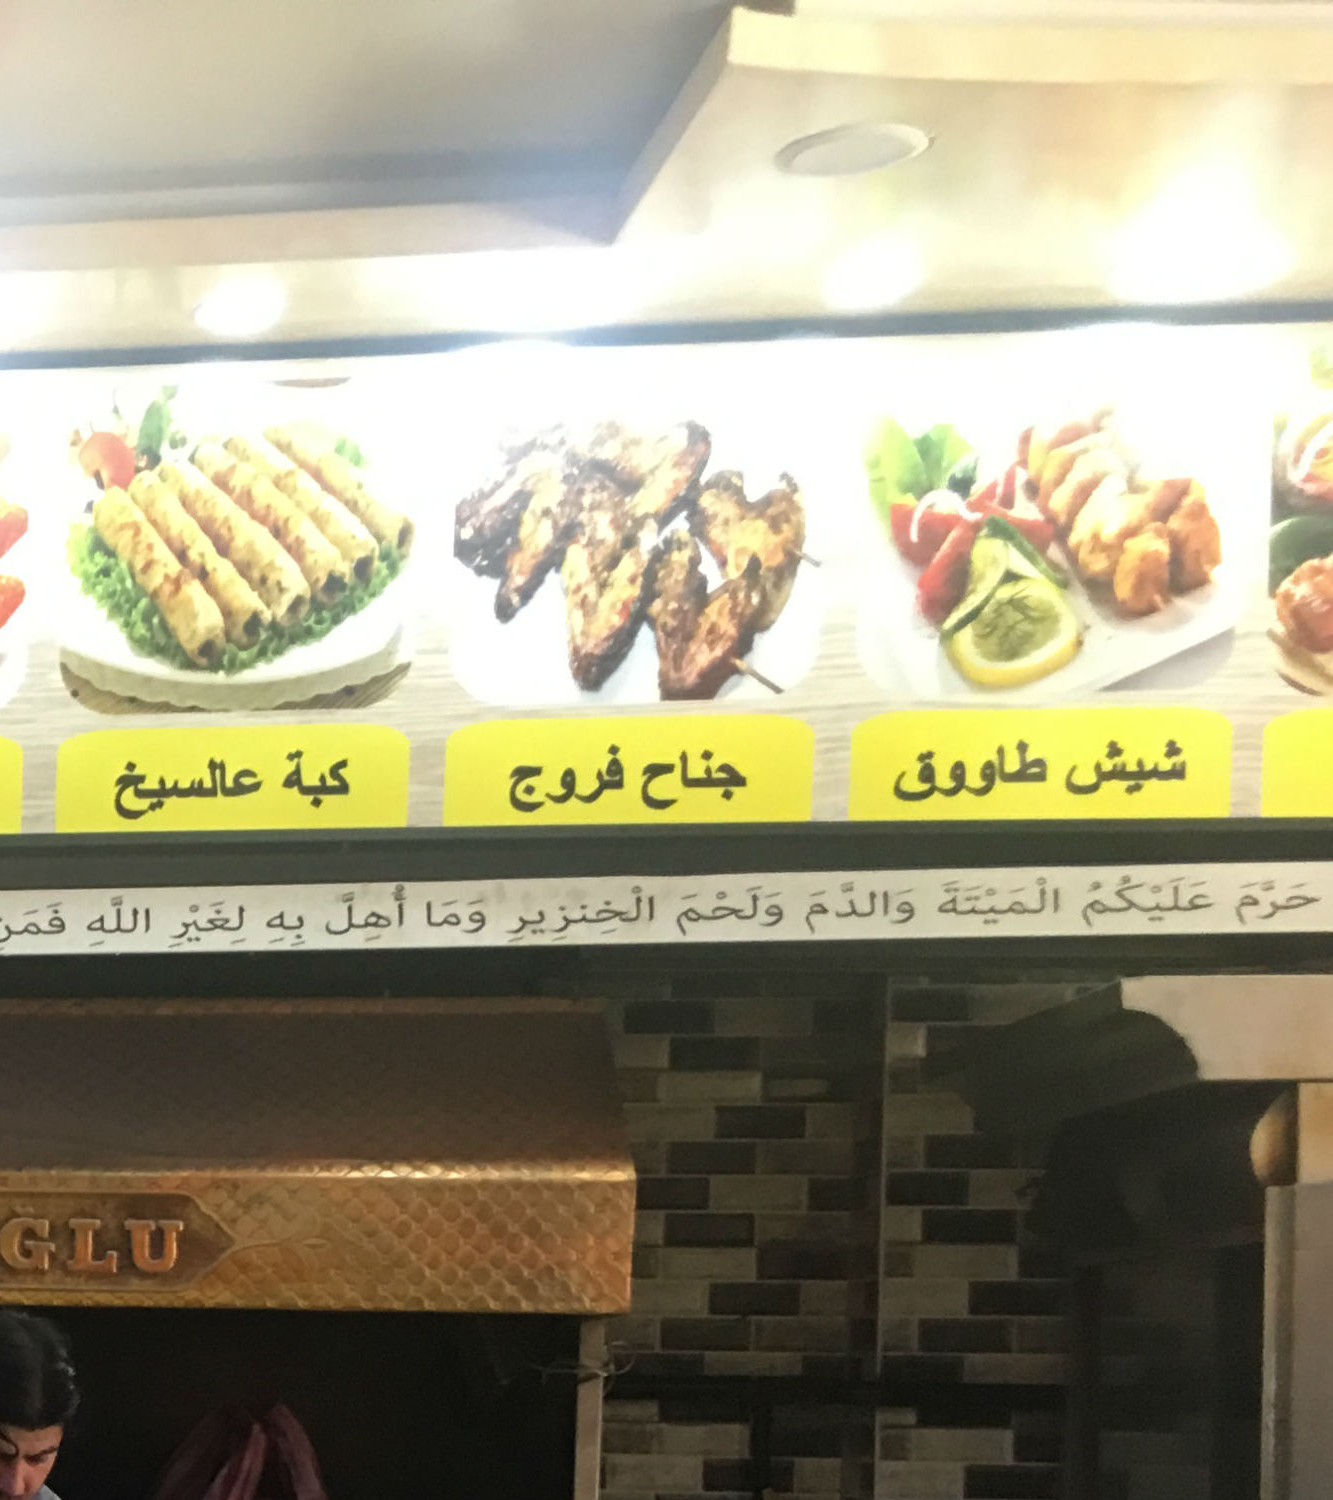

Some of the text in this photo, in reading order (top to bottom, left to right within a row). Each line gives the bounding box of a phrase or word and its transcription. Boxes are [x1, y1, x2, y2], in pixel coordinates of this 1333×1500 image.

[115, 751, 350, 819] كبة عالسيخ
[510, 745, 746, 812] جناح فروج
[894, 741, 1185, 801] شيش طاووق
